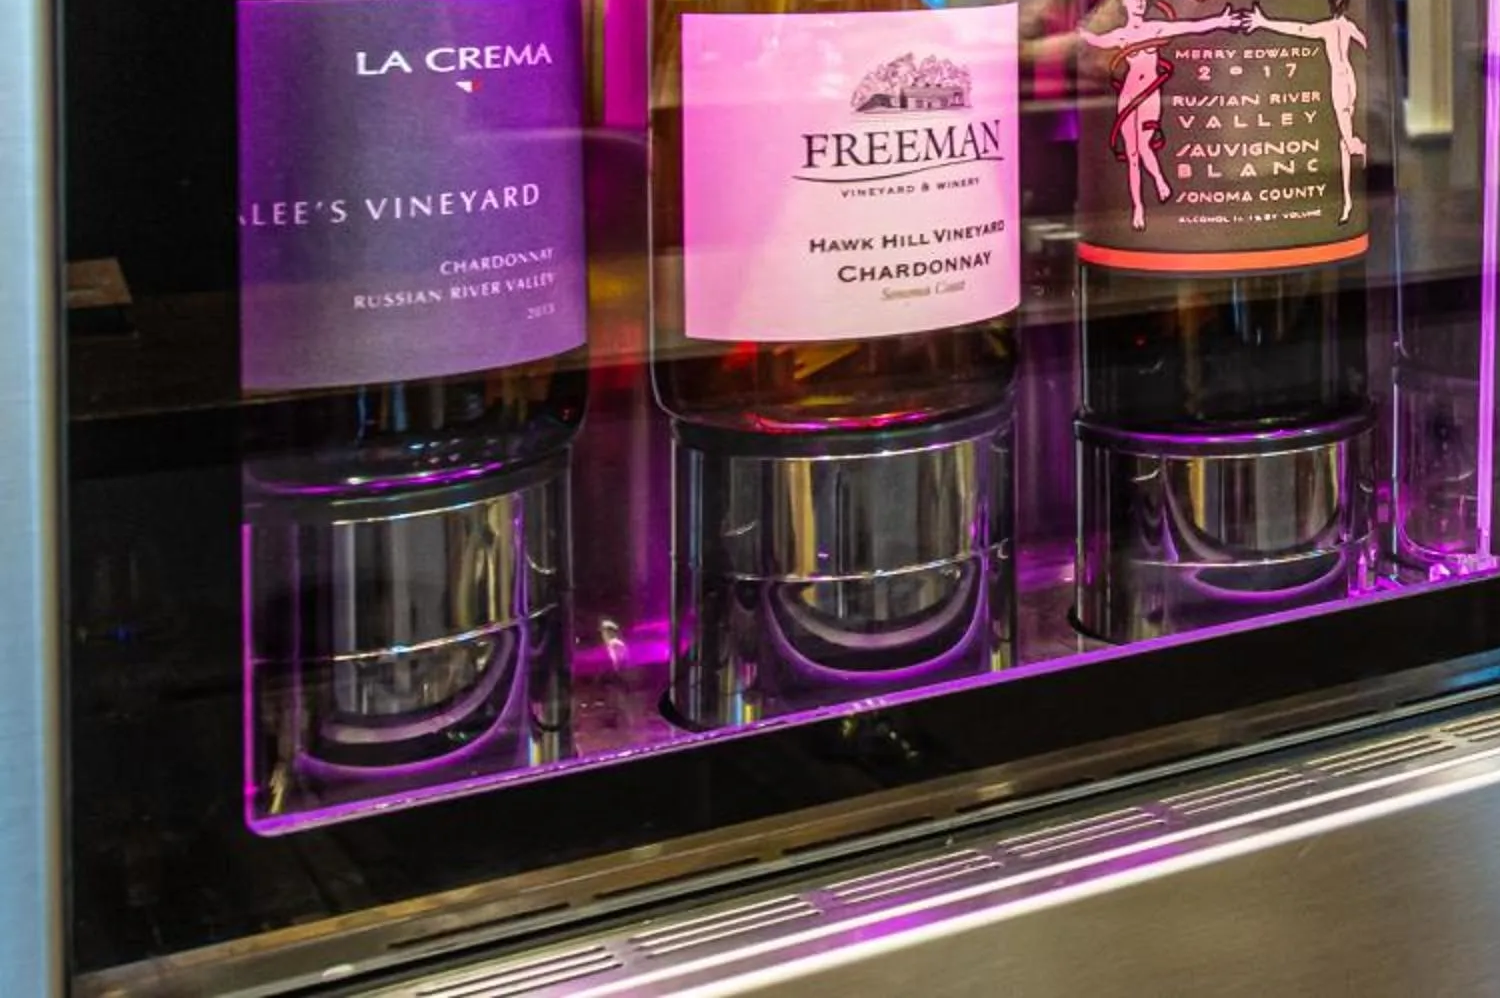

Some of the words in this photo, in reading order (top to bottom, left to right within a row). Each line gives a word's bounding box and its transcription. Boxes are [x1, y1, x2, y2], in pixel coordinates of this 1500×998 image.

[356, 50, 412, 75] LA
[425, 43, 553, 73] CREMA
[1174, 49, 1237, 60] MERRY
[1269, 91, 1322, 105] RIVER
[1178, 110, 1318, 130] VALLEY
[802, 119, 1001, 169] FREEMAN
[1177, 158, 1319, 179] BLANC
[841, 185, 916, 199] VINEYARD
[920, 182, 931, 193] &
[936, 177, 981, 191] WINERY
[1259, 183, 1327, 201] COUNTY
[366, 183, 541, 221] VINEYARD
[440, 247, 554, 276] CHARDONNAY
[353, 289, 444, 310] RUSSIAN
[450, 281, 501, 300] RIVER
[506, 271, 556, 292] VALLEY
